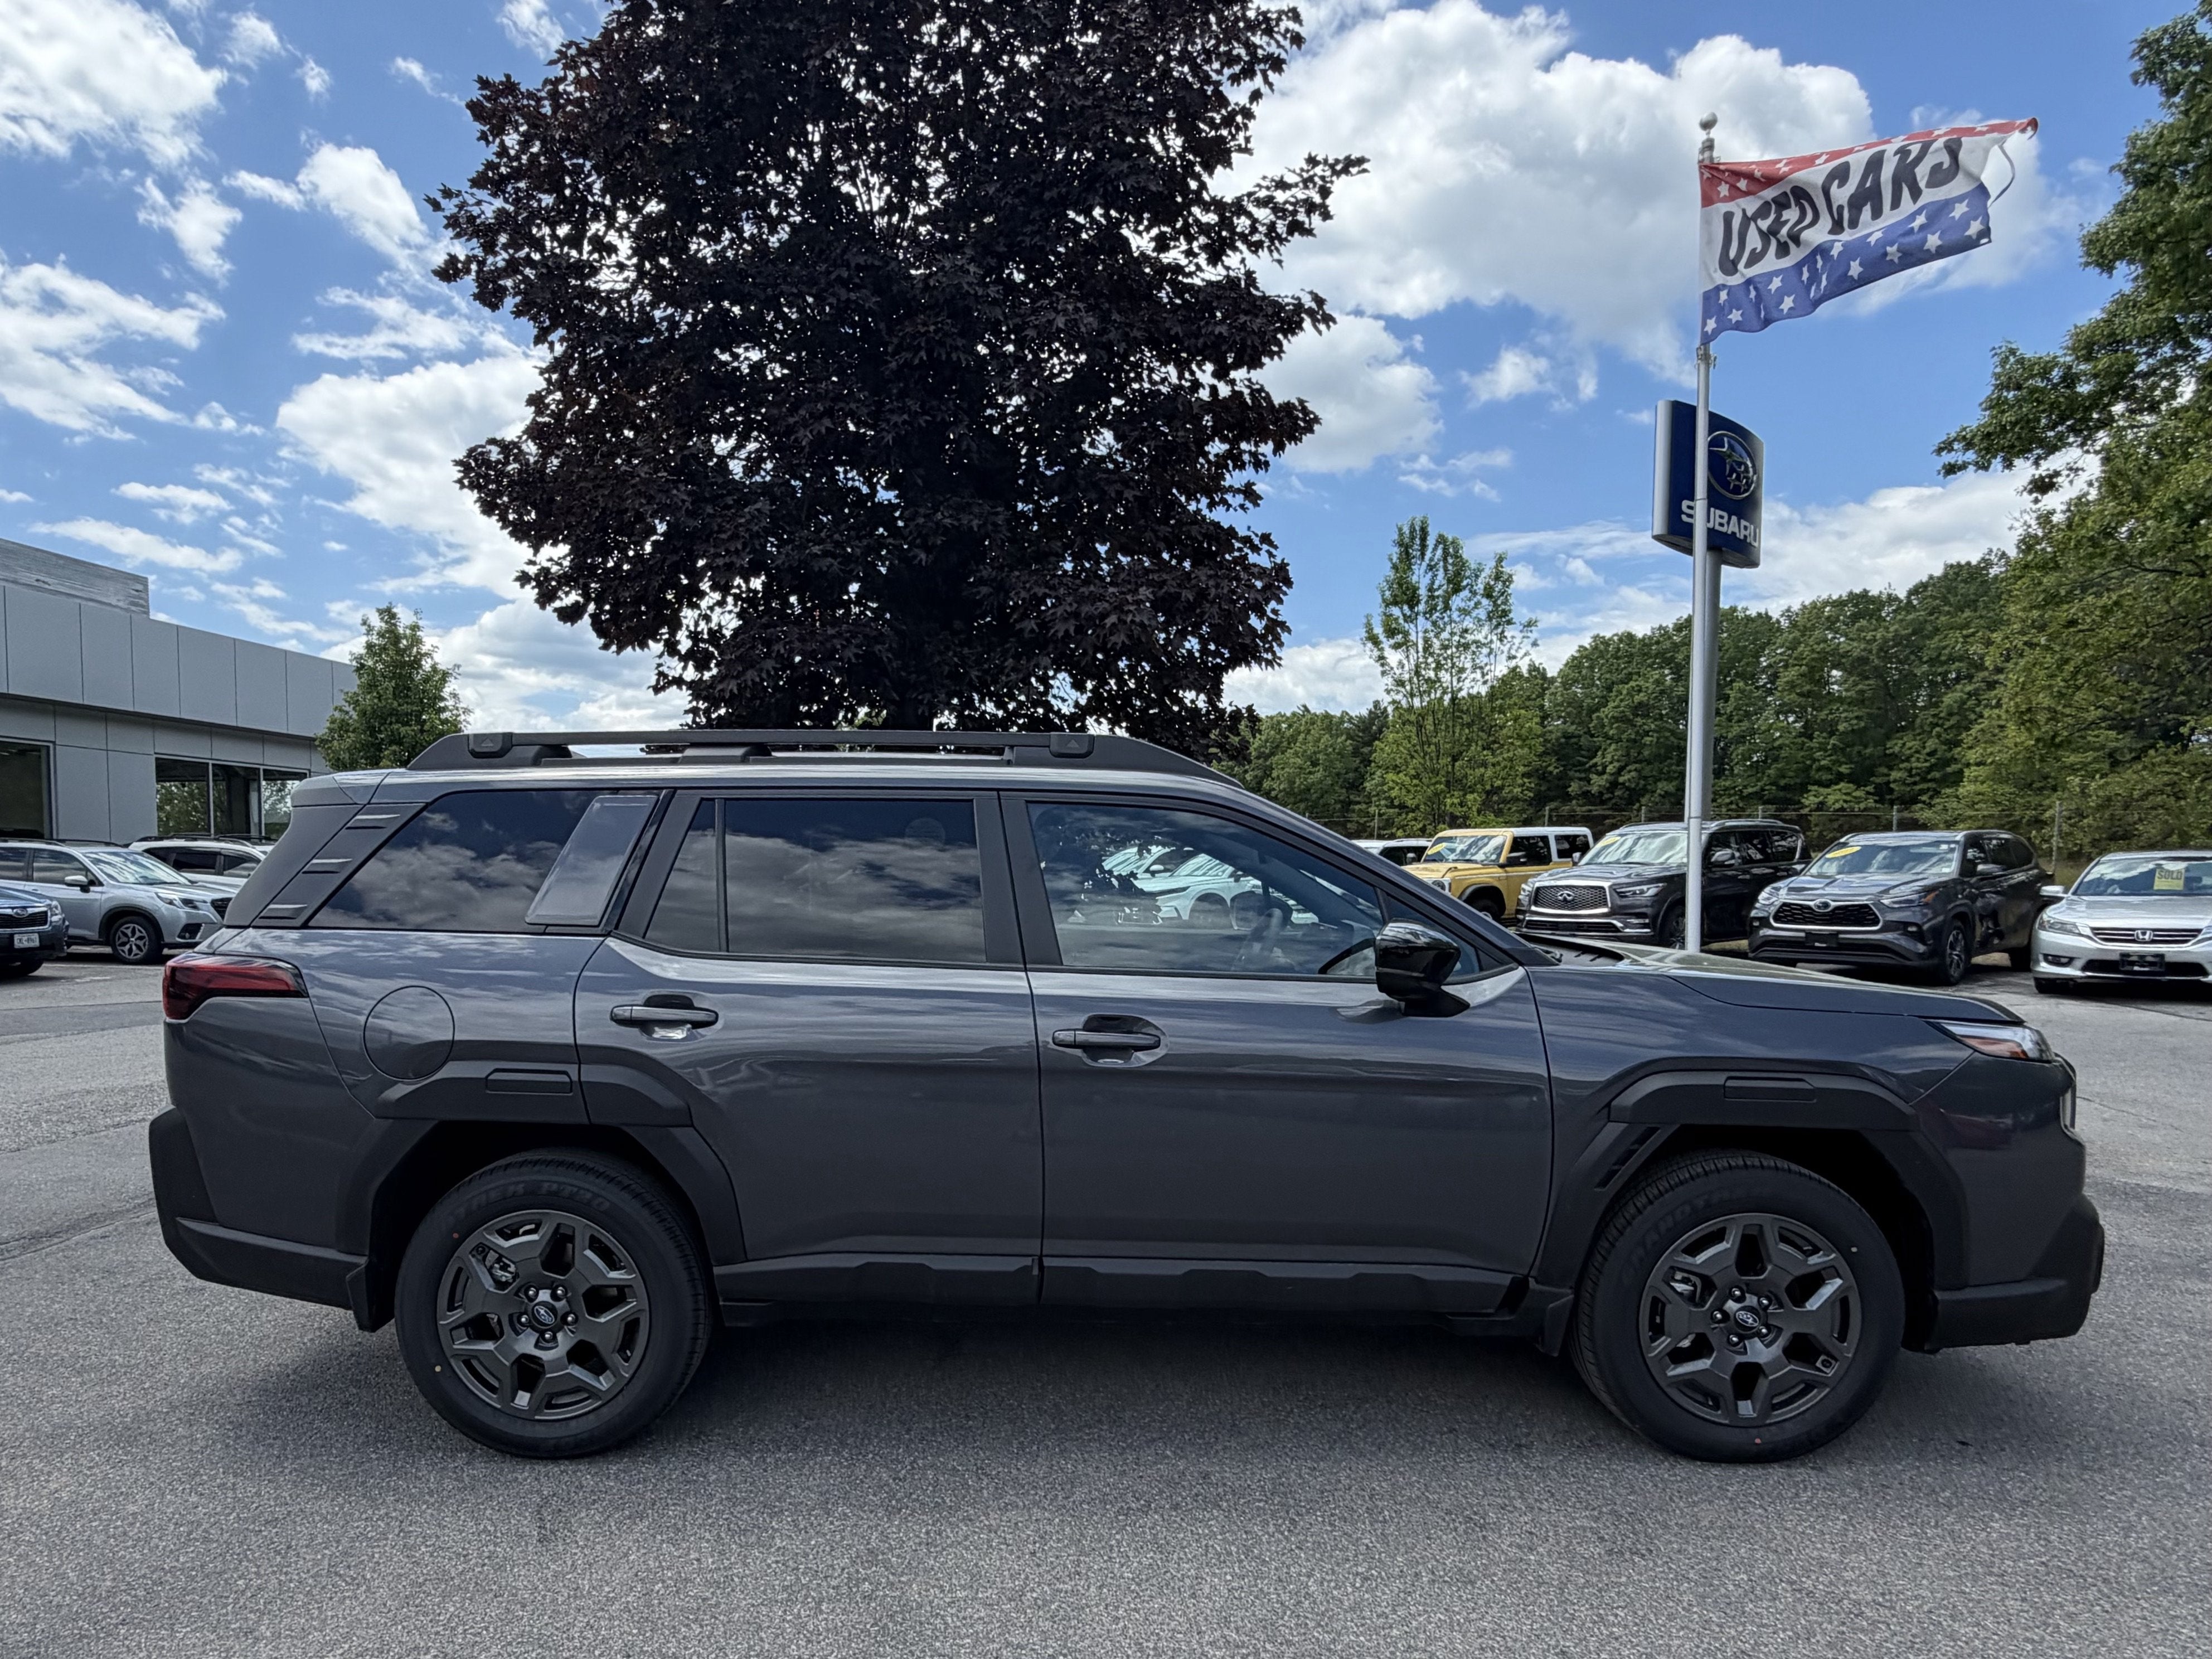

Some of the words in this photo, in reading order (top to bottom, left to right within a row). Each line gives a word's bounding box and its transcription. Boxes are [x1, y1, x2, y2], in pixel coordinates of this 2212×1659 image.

[1719, 185, 1820, 277] USED
[1821, 137, 1963, 235] CARS
[2157, 870, 2183, 880] SOLD
